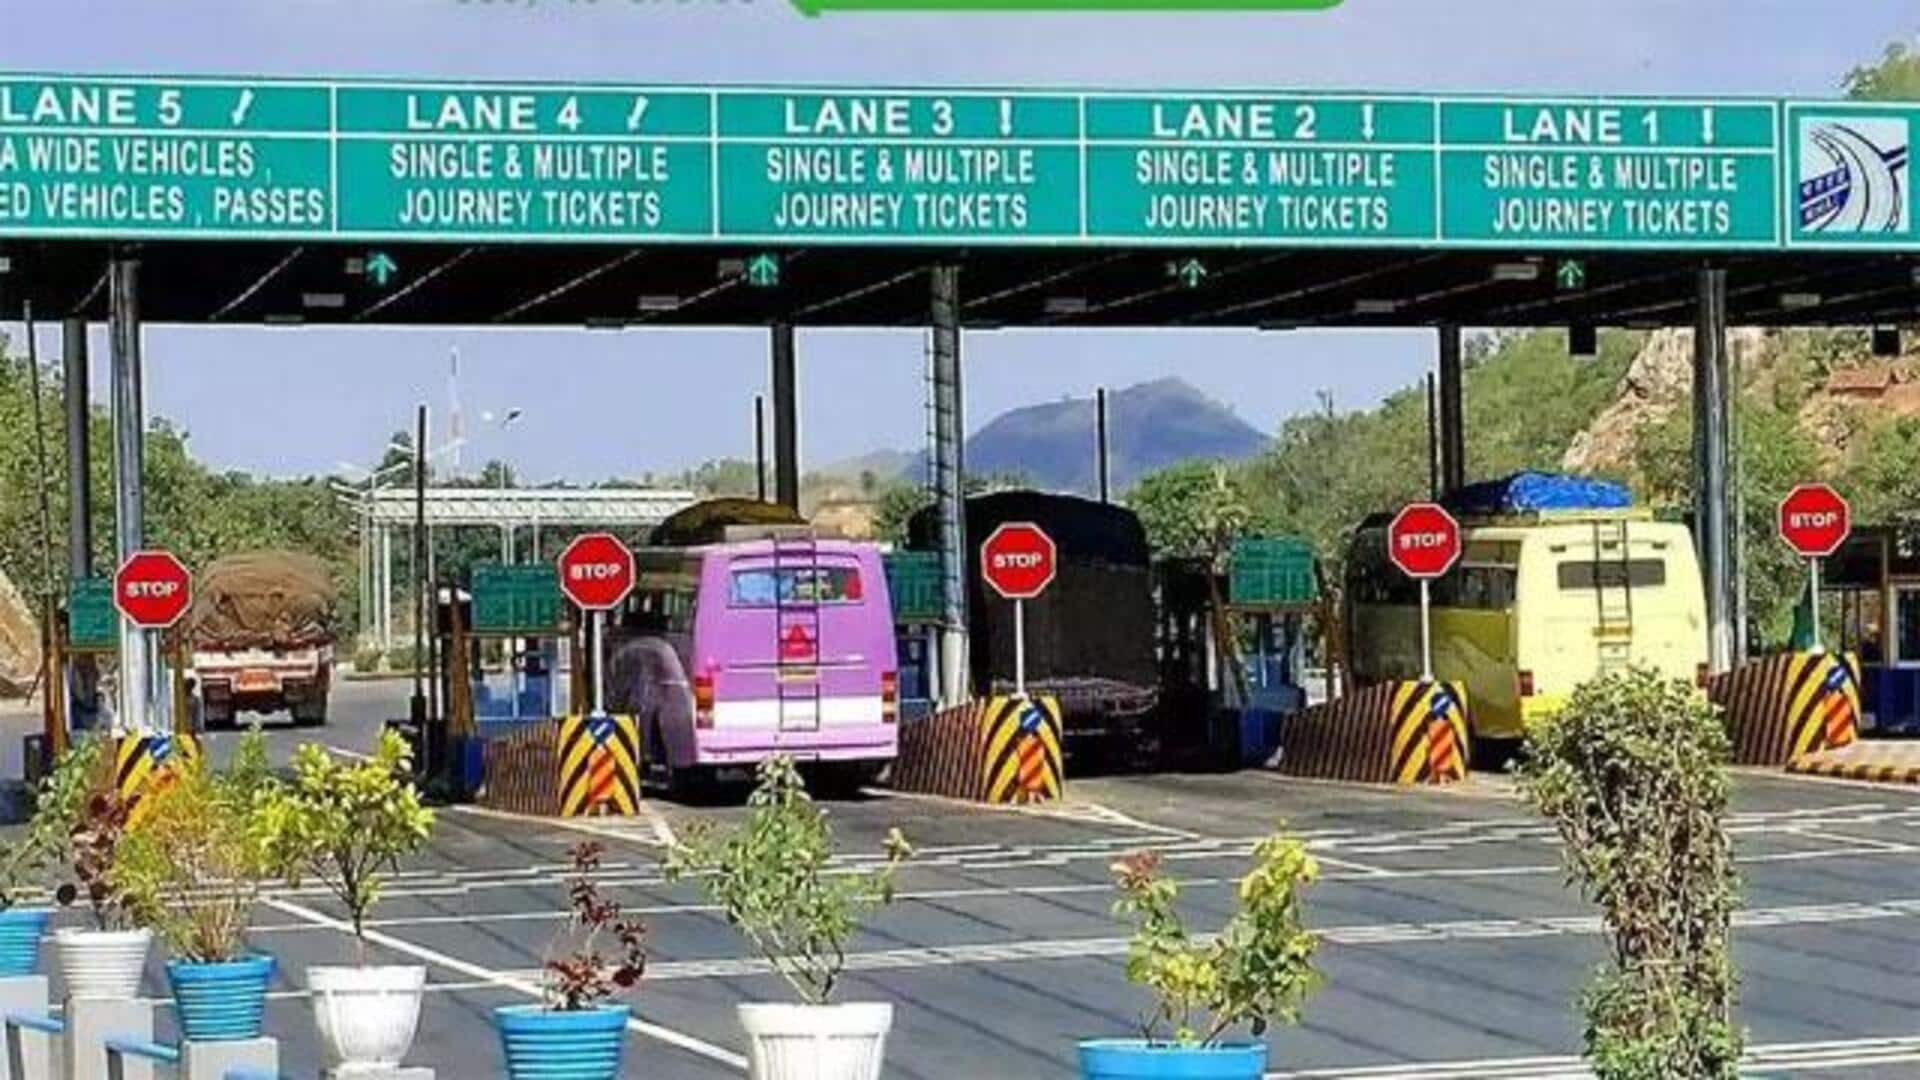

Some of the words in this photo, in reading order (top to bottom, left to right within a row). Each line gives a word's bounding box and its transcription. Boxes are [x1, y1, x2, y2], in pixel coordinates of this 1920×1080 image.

[2, 87, 135, 123] LANE
[157, 90, 182, 126] 5
[406, 96, 536, 131] LANE
[556, 97, 581, 130] 4
[785, 100, 910, 134] LANE
[932, 100, 953, 135] 3
[1153, 105, 1274, 139] LANE
[1295, 105, 1316, 139] 2
[1504, 110, 1621, 143] LANE
[1641, 111, 1658, 144] 1
[27, 137, 101, 173] WIDE
[113, 140, 254, 177] VEHICLES
[391, 143, 493, 179] SINGLE
[504, 144, 522, 178] &
[534, 145, 670, 181] MULTIPLE
[767, 148, 864, 183] SINGLE
[877, 149, 893, 183] &
[905, 149, 1035, 183] MULTIPLE
[1136, 149, 1231, 185] SINGLE
[1242, 151, 1258, 185] &
[1269, 152, 1396, 187] MULTIPLE
[1484, 154, 1577, 189] SINGLE
[1588, 156, 1604, 189] &
[1615, 156, 1737, 191] MULTIPLE
[42, 183, 185, 221] VEHICLES
[213, 187, 325, 224] PASSES
[400, 189, 531, 224] JOURNEY
[543, 191, 661, 226] TICKETS
[775, 194, 903, 228] JOURNEY
[914, 194, 1028, 228] TICKETS
[1145, 195, 1267, 230] JOURNEY
[1278, 196, 1389, 231] TICKETS
[1493, 198, 1613, 233] JOURNEY
[1623, 200, 1730, 234] TICKETS
[1789, 511, 1838, 529] STOP
[1399, 532, 1447, 549] STOP
[569, 562, 622, 580] STOP
[993, 552, 1042, 569] STOP
[126, 581, 178, 598] STOP
